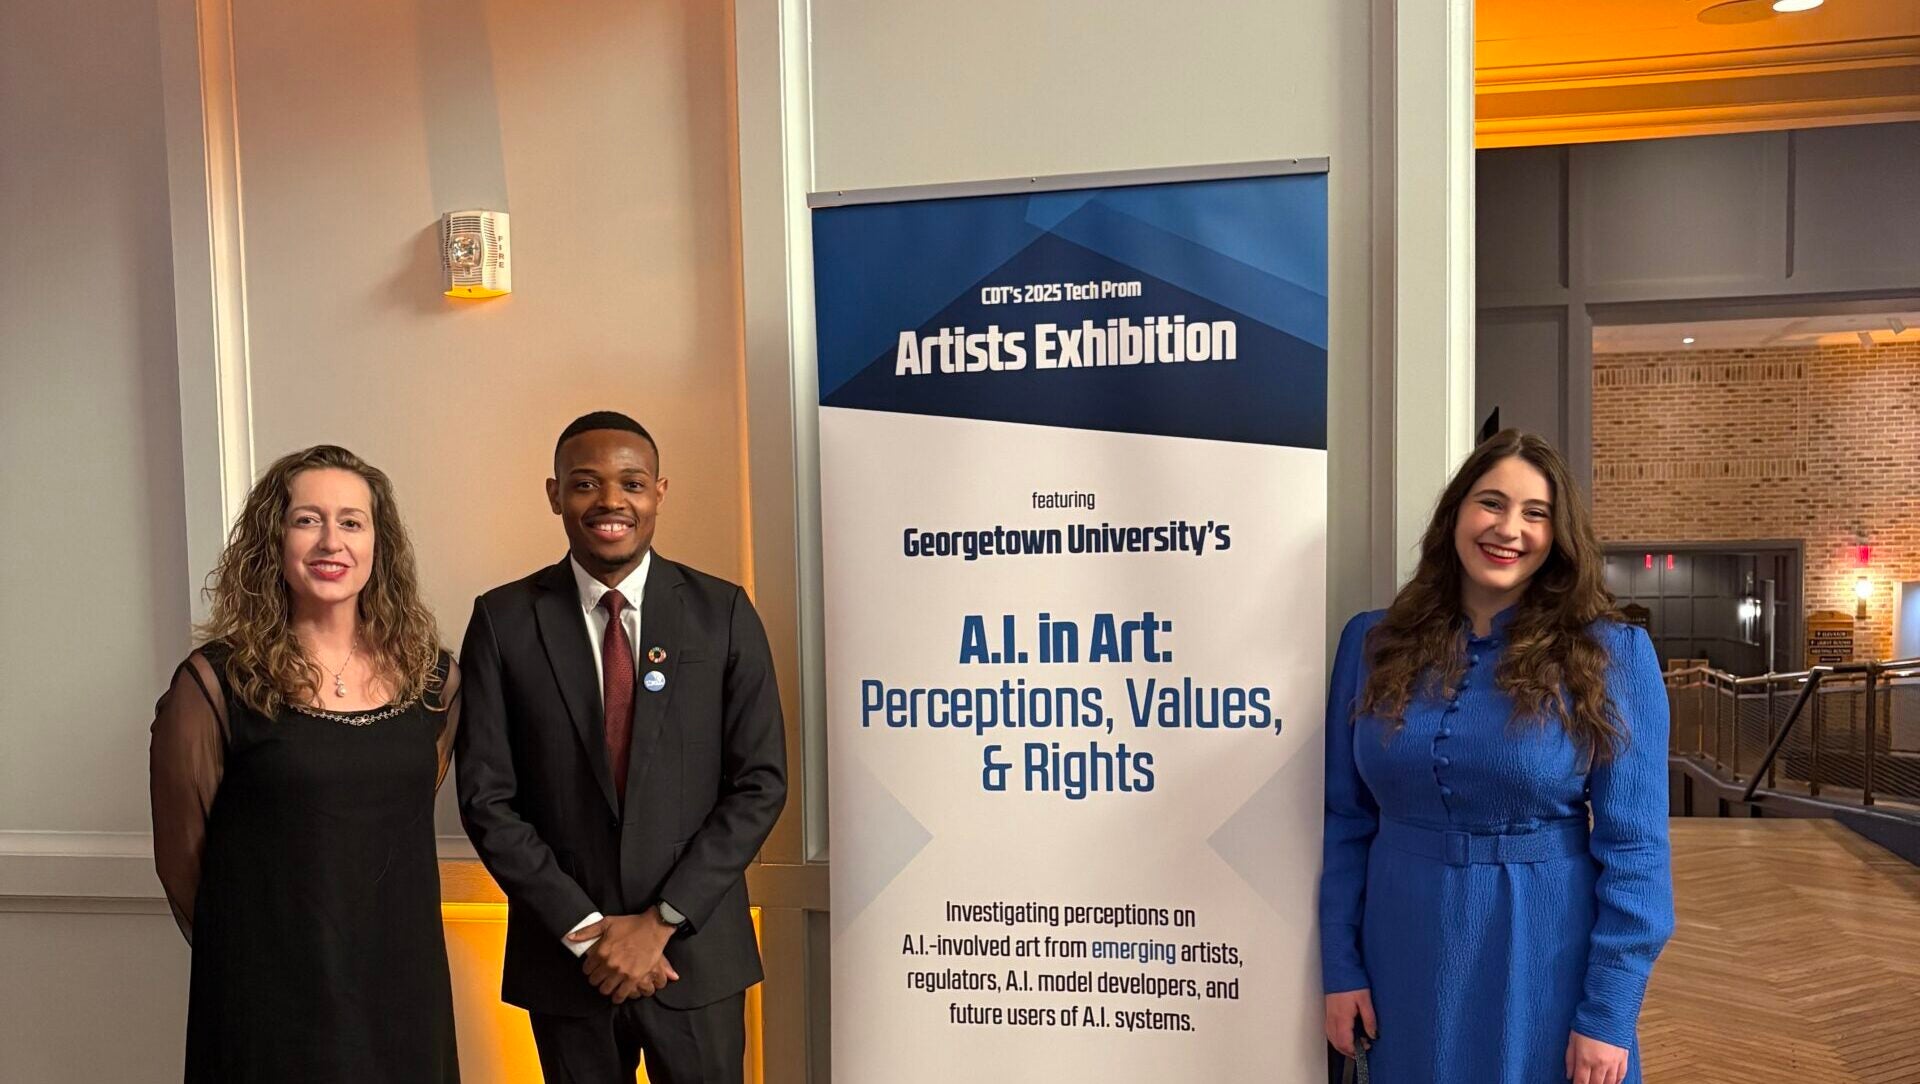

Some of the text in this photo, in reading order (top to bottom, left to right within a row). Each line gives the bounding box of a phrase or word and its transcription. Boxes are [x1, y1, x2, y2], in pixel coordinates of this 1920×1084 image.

[982, 281, 1141, 304] CDT's 2025 Tech Prom
[896, 315, 1236, 375] Artists Exhibition
[1032, 491, 1095, 510] featuring
[904, 521, 1230, 560] Georgetown University's
[959, 612, 1172, 664] A.I. in Art:
[862, 677, 1282, 736] Perceptions, Values,
[983, 741, 1154, 800] & Rights
[947, 901, 1195, 927] Investigating perceptions on
[903, 934, 1242, 967] A.I.-involved art from emerging artists,
[908, 968, 1238, 999] regulators, A.I. model developers, and
[950, 1003, 1195, 1032] future users of A.I. systems.
